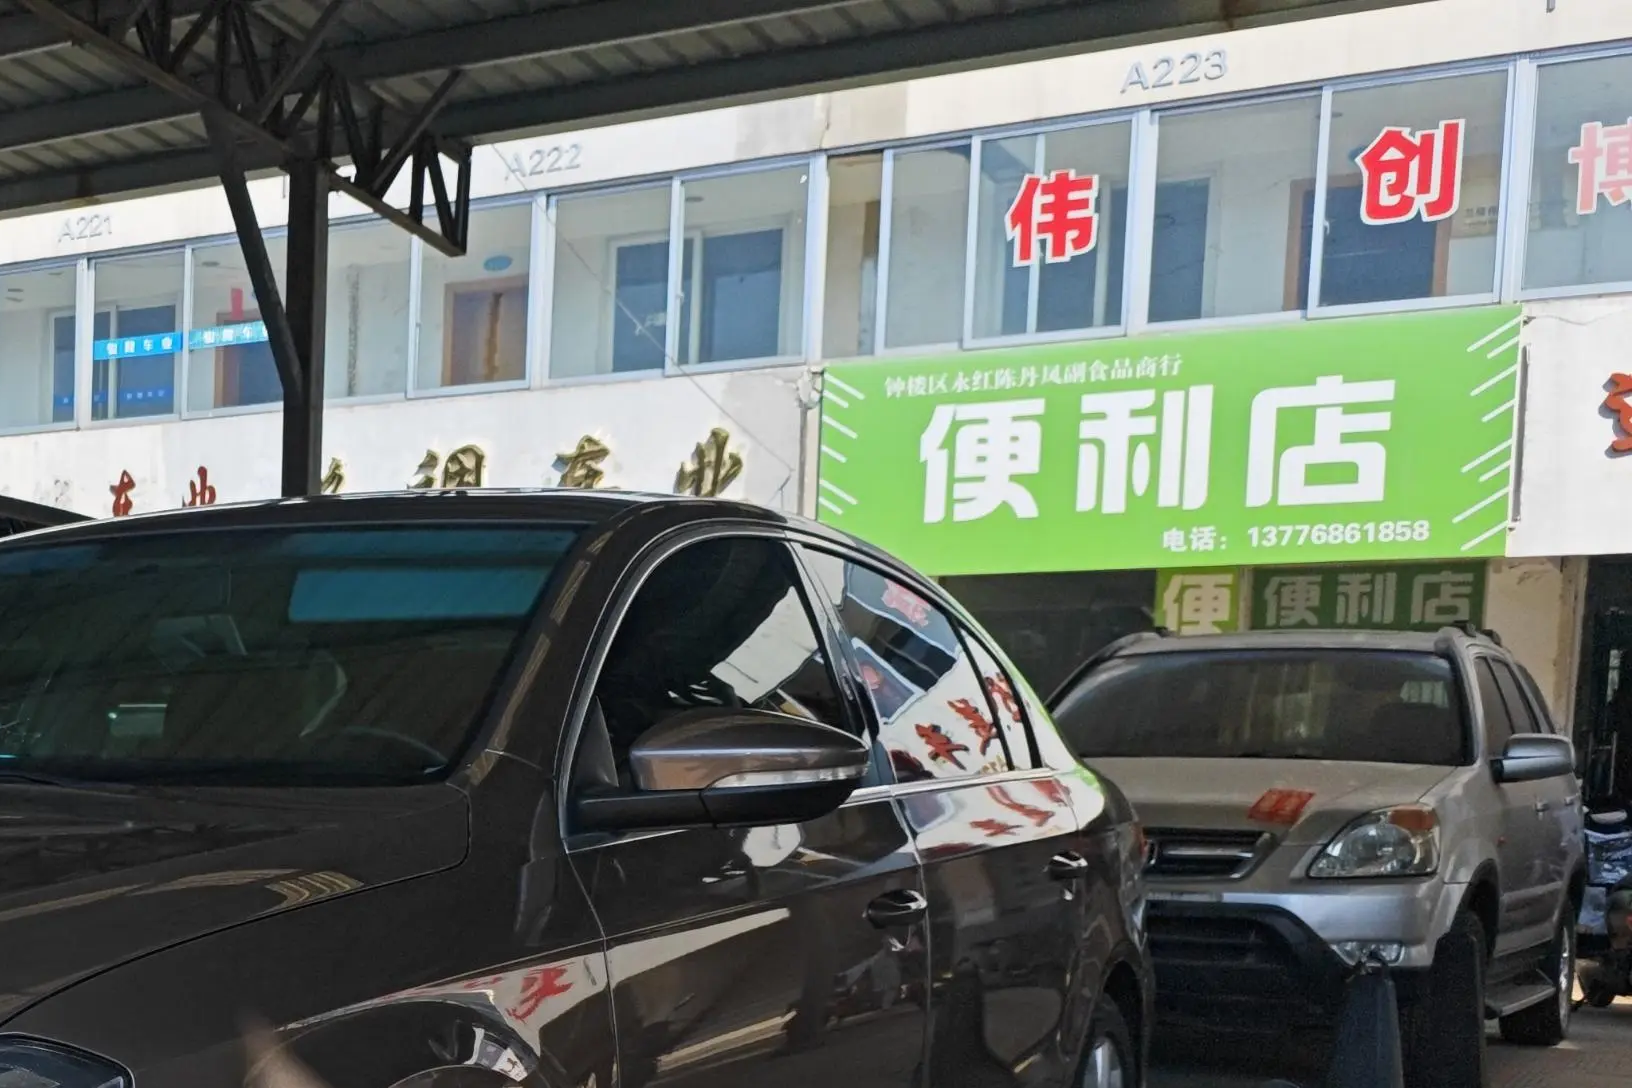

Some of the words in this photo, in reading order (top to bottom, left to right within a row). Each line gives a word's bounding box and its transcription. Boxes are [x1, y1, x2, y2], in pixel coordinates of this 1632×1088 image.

[1119, 48, 1229, 95] A223
[503, 142, 582, 183] A222
[1005, 168, 1100, 268] 伟
[1354, 118, 1466, 226] 创
[57, 213, 113, 244] A221
[919, 374, 1397, 524] 便利店
[1246, 518, 1431, 548] 13776861858
[1163, 572, 1235, 637] 便
[1263, 570, 1475, 627] 便利店
